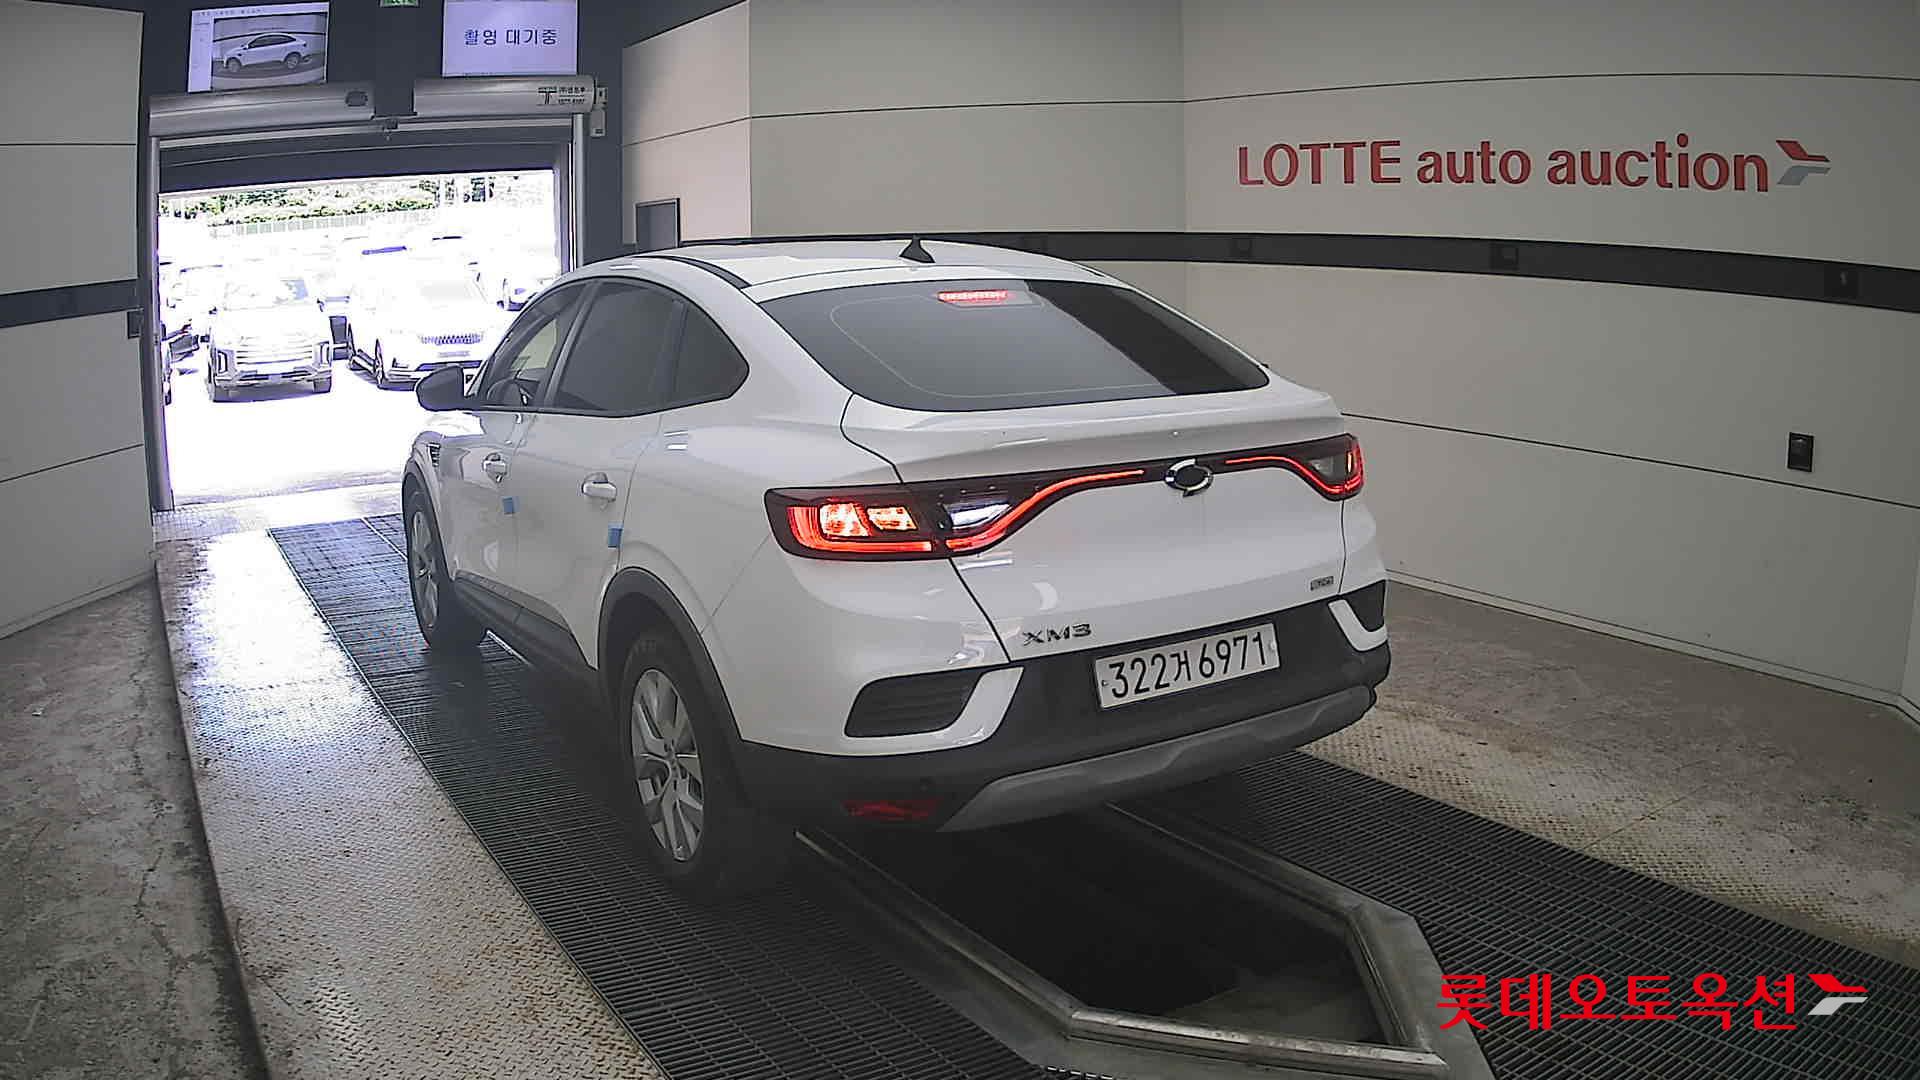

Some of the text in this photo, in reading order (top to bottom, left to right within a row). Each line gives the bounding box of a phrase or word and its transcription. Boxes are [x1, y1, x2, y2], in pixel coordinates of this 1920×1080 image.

[506, 29, 558, 45] 대기중
[1238, 133, 1769, 193] LOTTE auto auction
[1023, 623, 1091, 646] XM3
